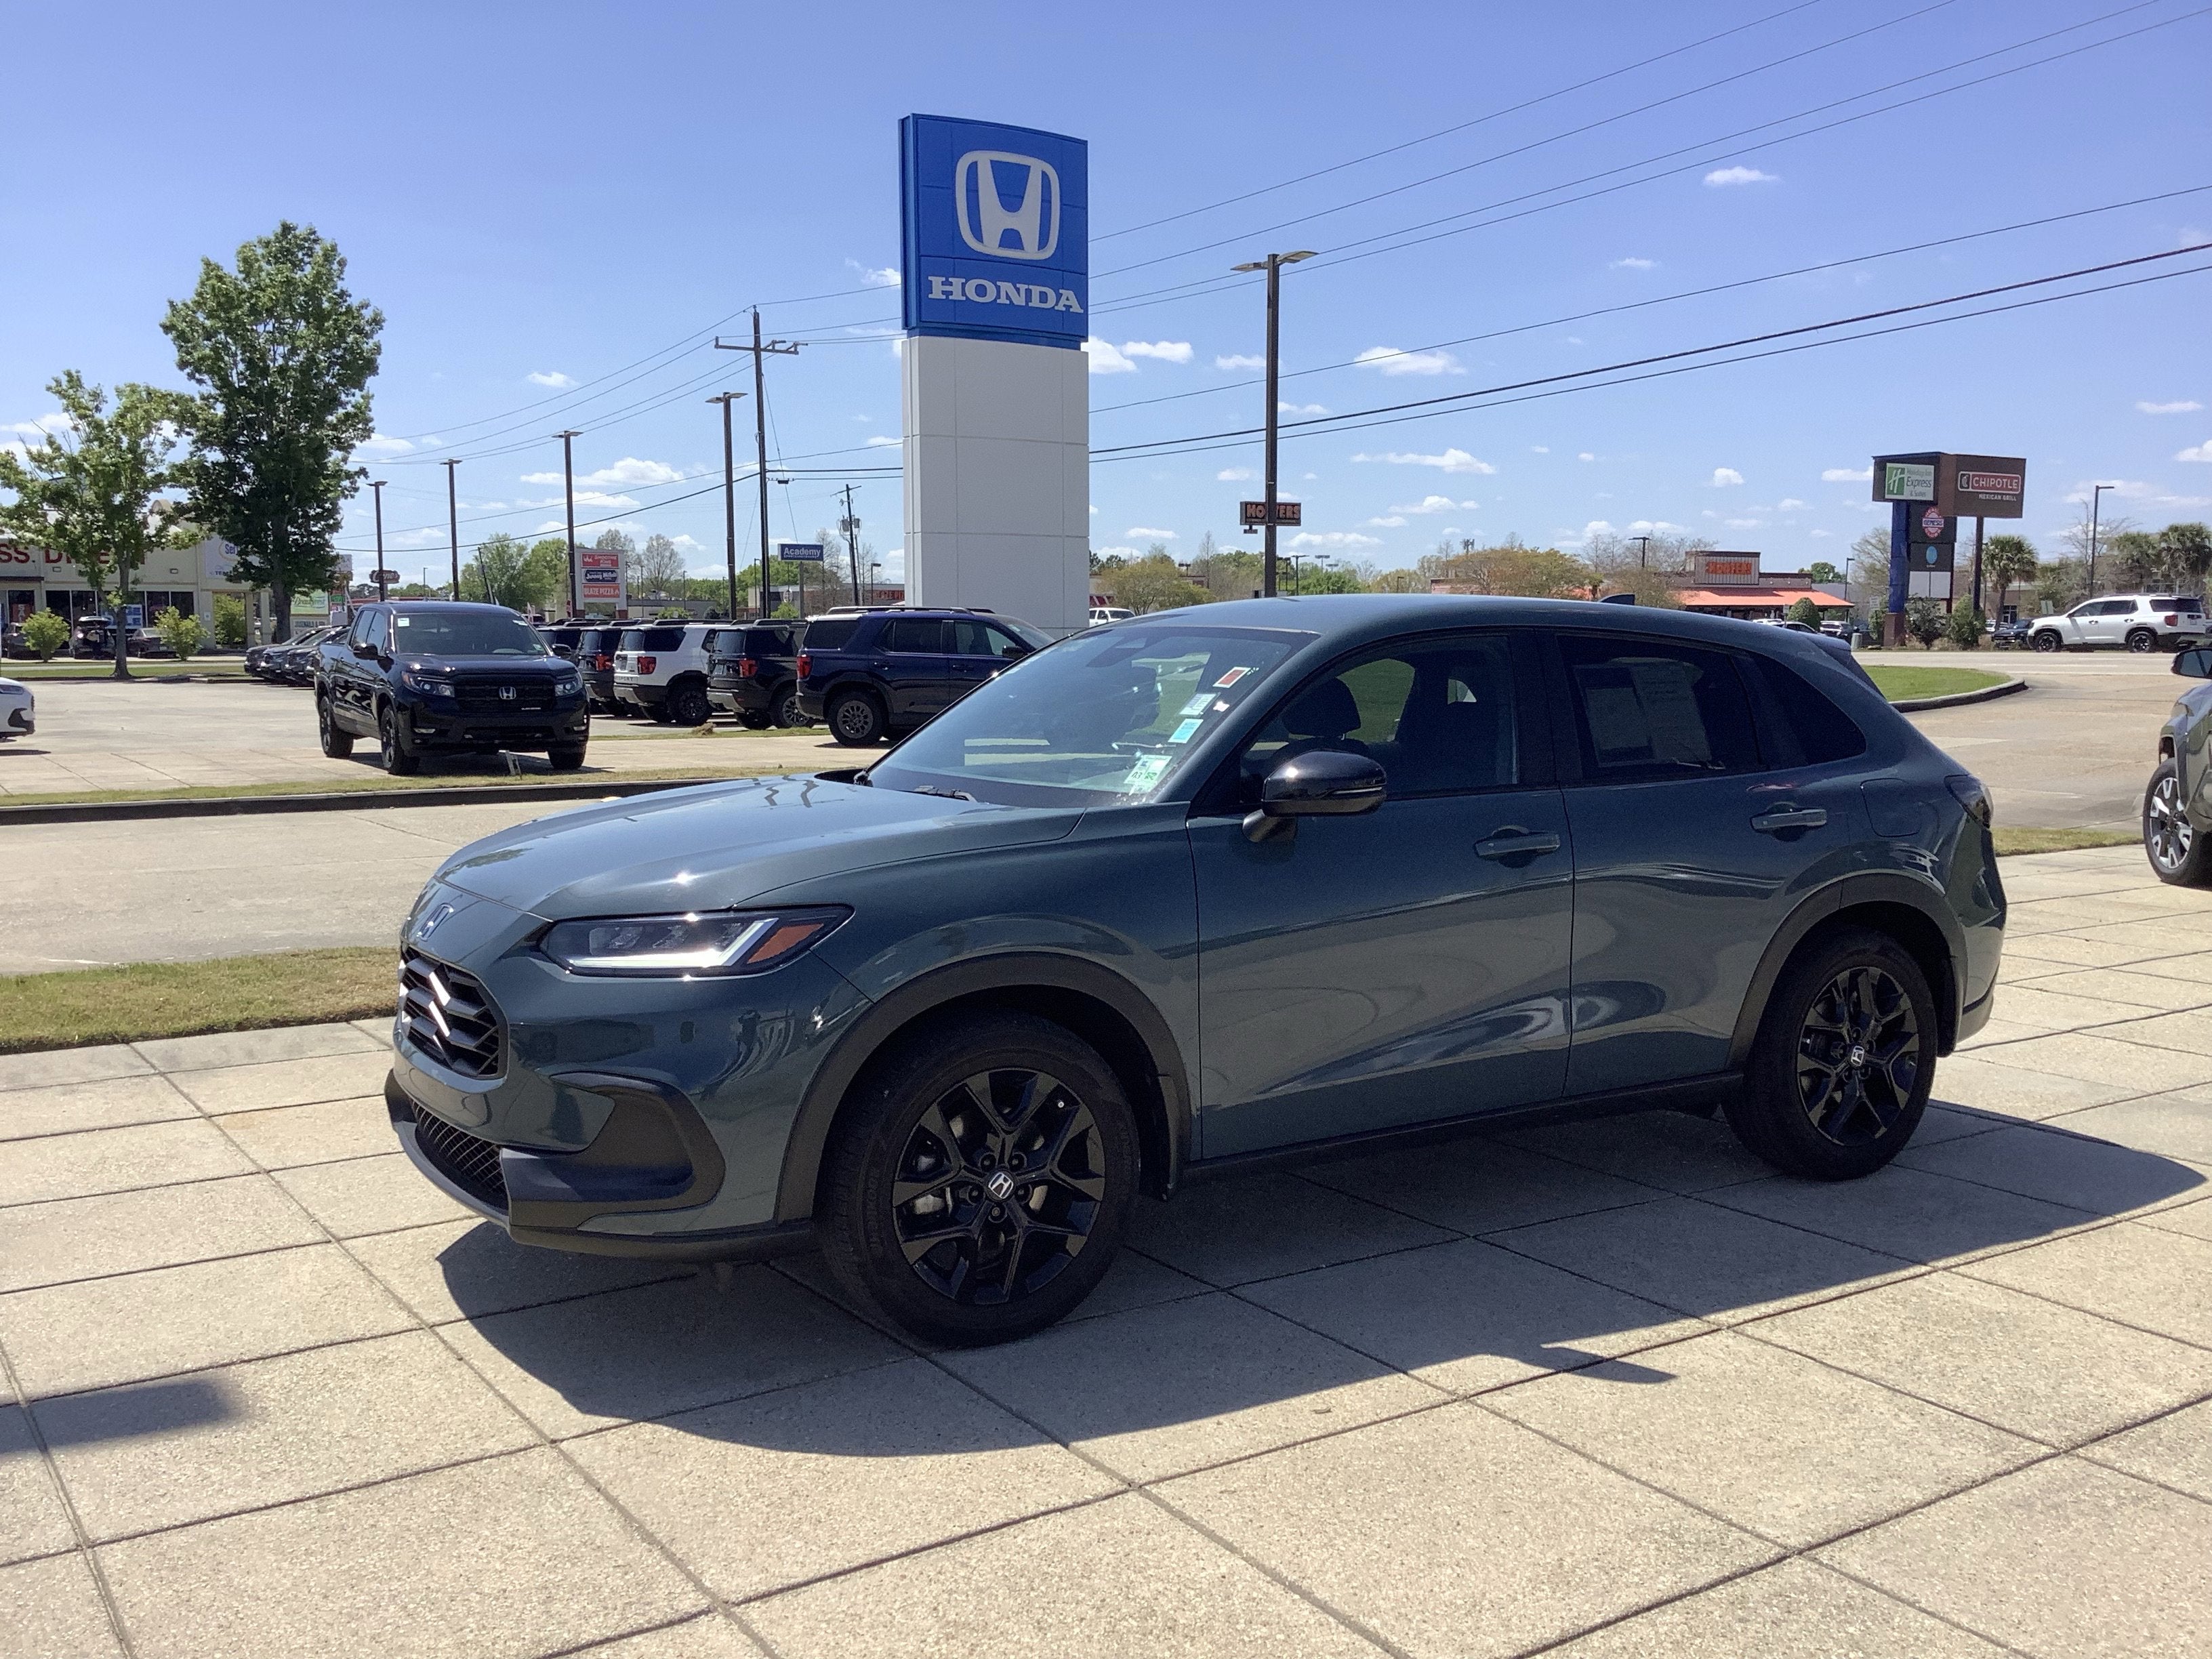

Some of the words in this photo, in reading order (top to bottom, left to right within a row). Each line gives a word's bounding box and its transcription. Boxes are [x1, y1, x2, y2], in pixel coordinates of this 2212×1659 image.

[928, 276, 1084, 314] HONDA
[1906, 476, 1931, 489] Express
[1973, 476, 2018, 489] CHIPOTLE
[1246, 504, 1300, 519] HOERS
[783, 547, 821, 558] Academy
